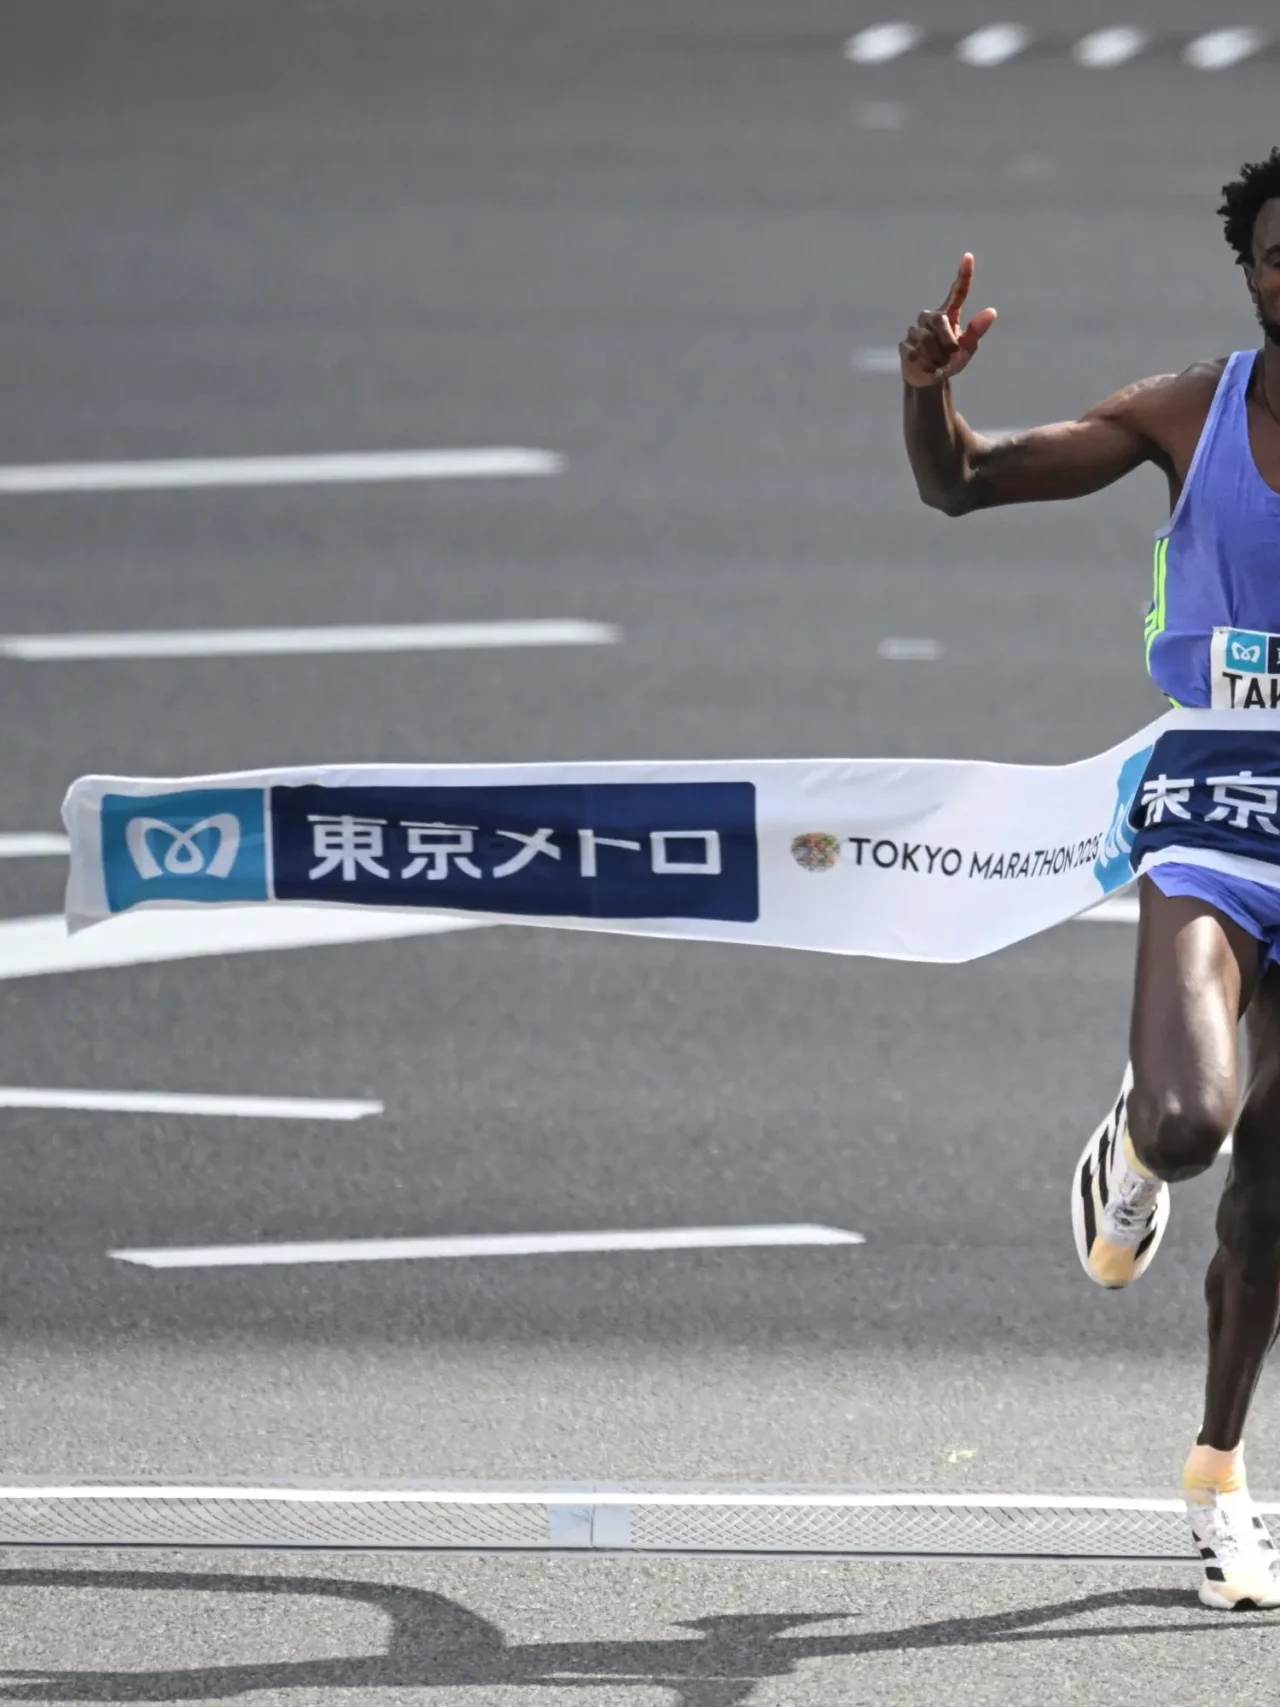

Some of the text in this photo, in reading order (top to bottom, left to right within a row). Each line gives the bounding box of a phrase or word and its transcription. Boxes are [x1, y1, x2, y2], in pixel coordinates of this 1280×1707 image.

[306, 813, 722, 881] 東京メトロ
[848, 837, 963, 877] TOKYO
[968, 844, 1076, 880] MARATHON
